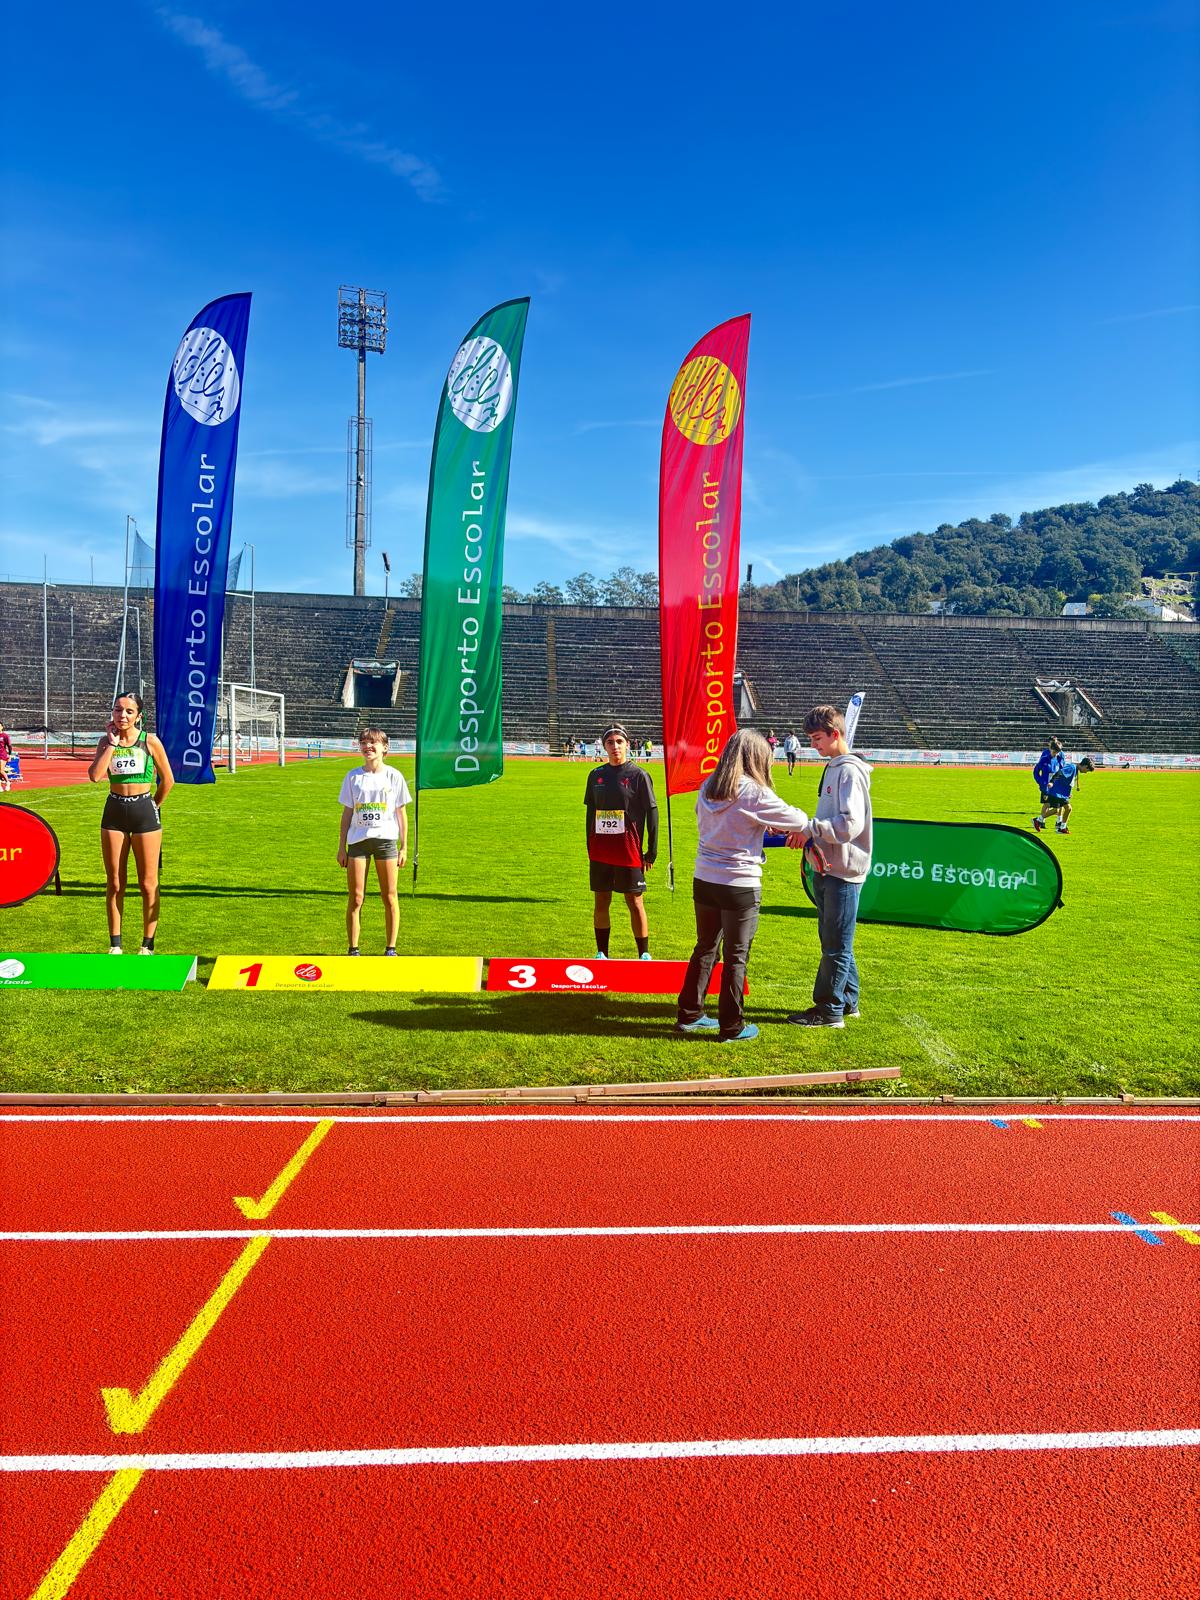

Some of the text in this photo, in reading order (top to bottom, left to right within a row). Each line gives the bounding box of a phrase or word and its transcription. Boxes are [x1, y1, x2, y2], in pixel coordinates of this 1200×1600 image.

[182, 453, 216, 768] Desporto Escolar
[454, 460, 486, 773] Desporto Escolar
[696, 471, 727, 775] Desporto Escolar
[116, 759, 136, 768] 676
[362, 813, 381, 821] 593
[601, 820, 618, 828] 792
[931, 863, 1027, 890] Escolar
[239, 963, 263, 987] 1
[507, 964, 537, 989] 3
